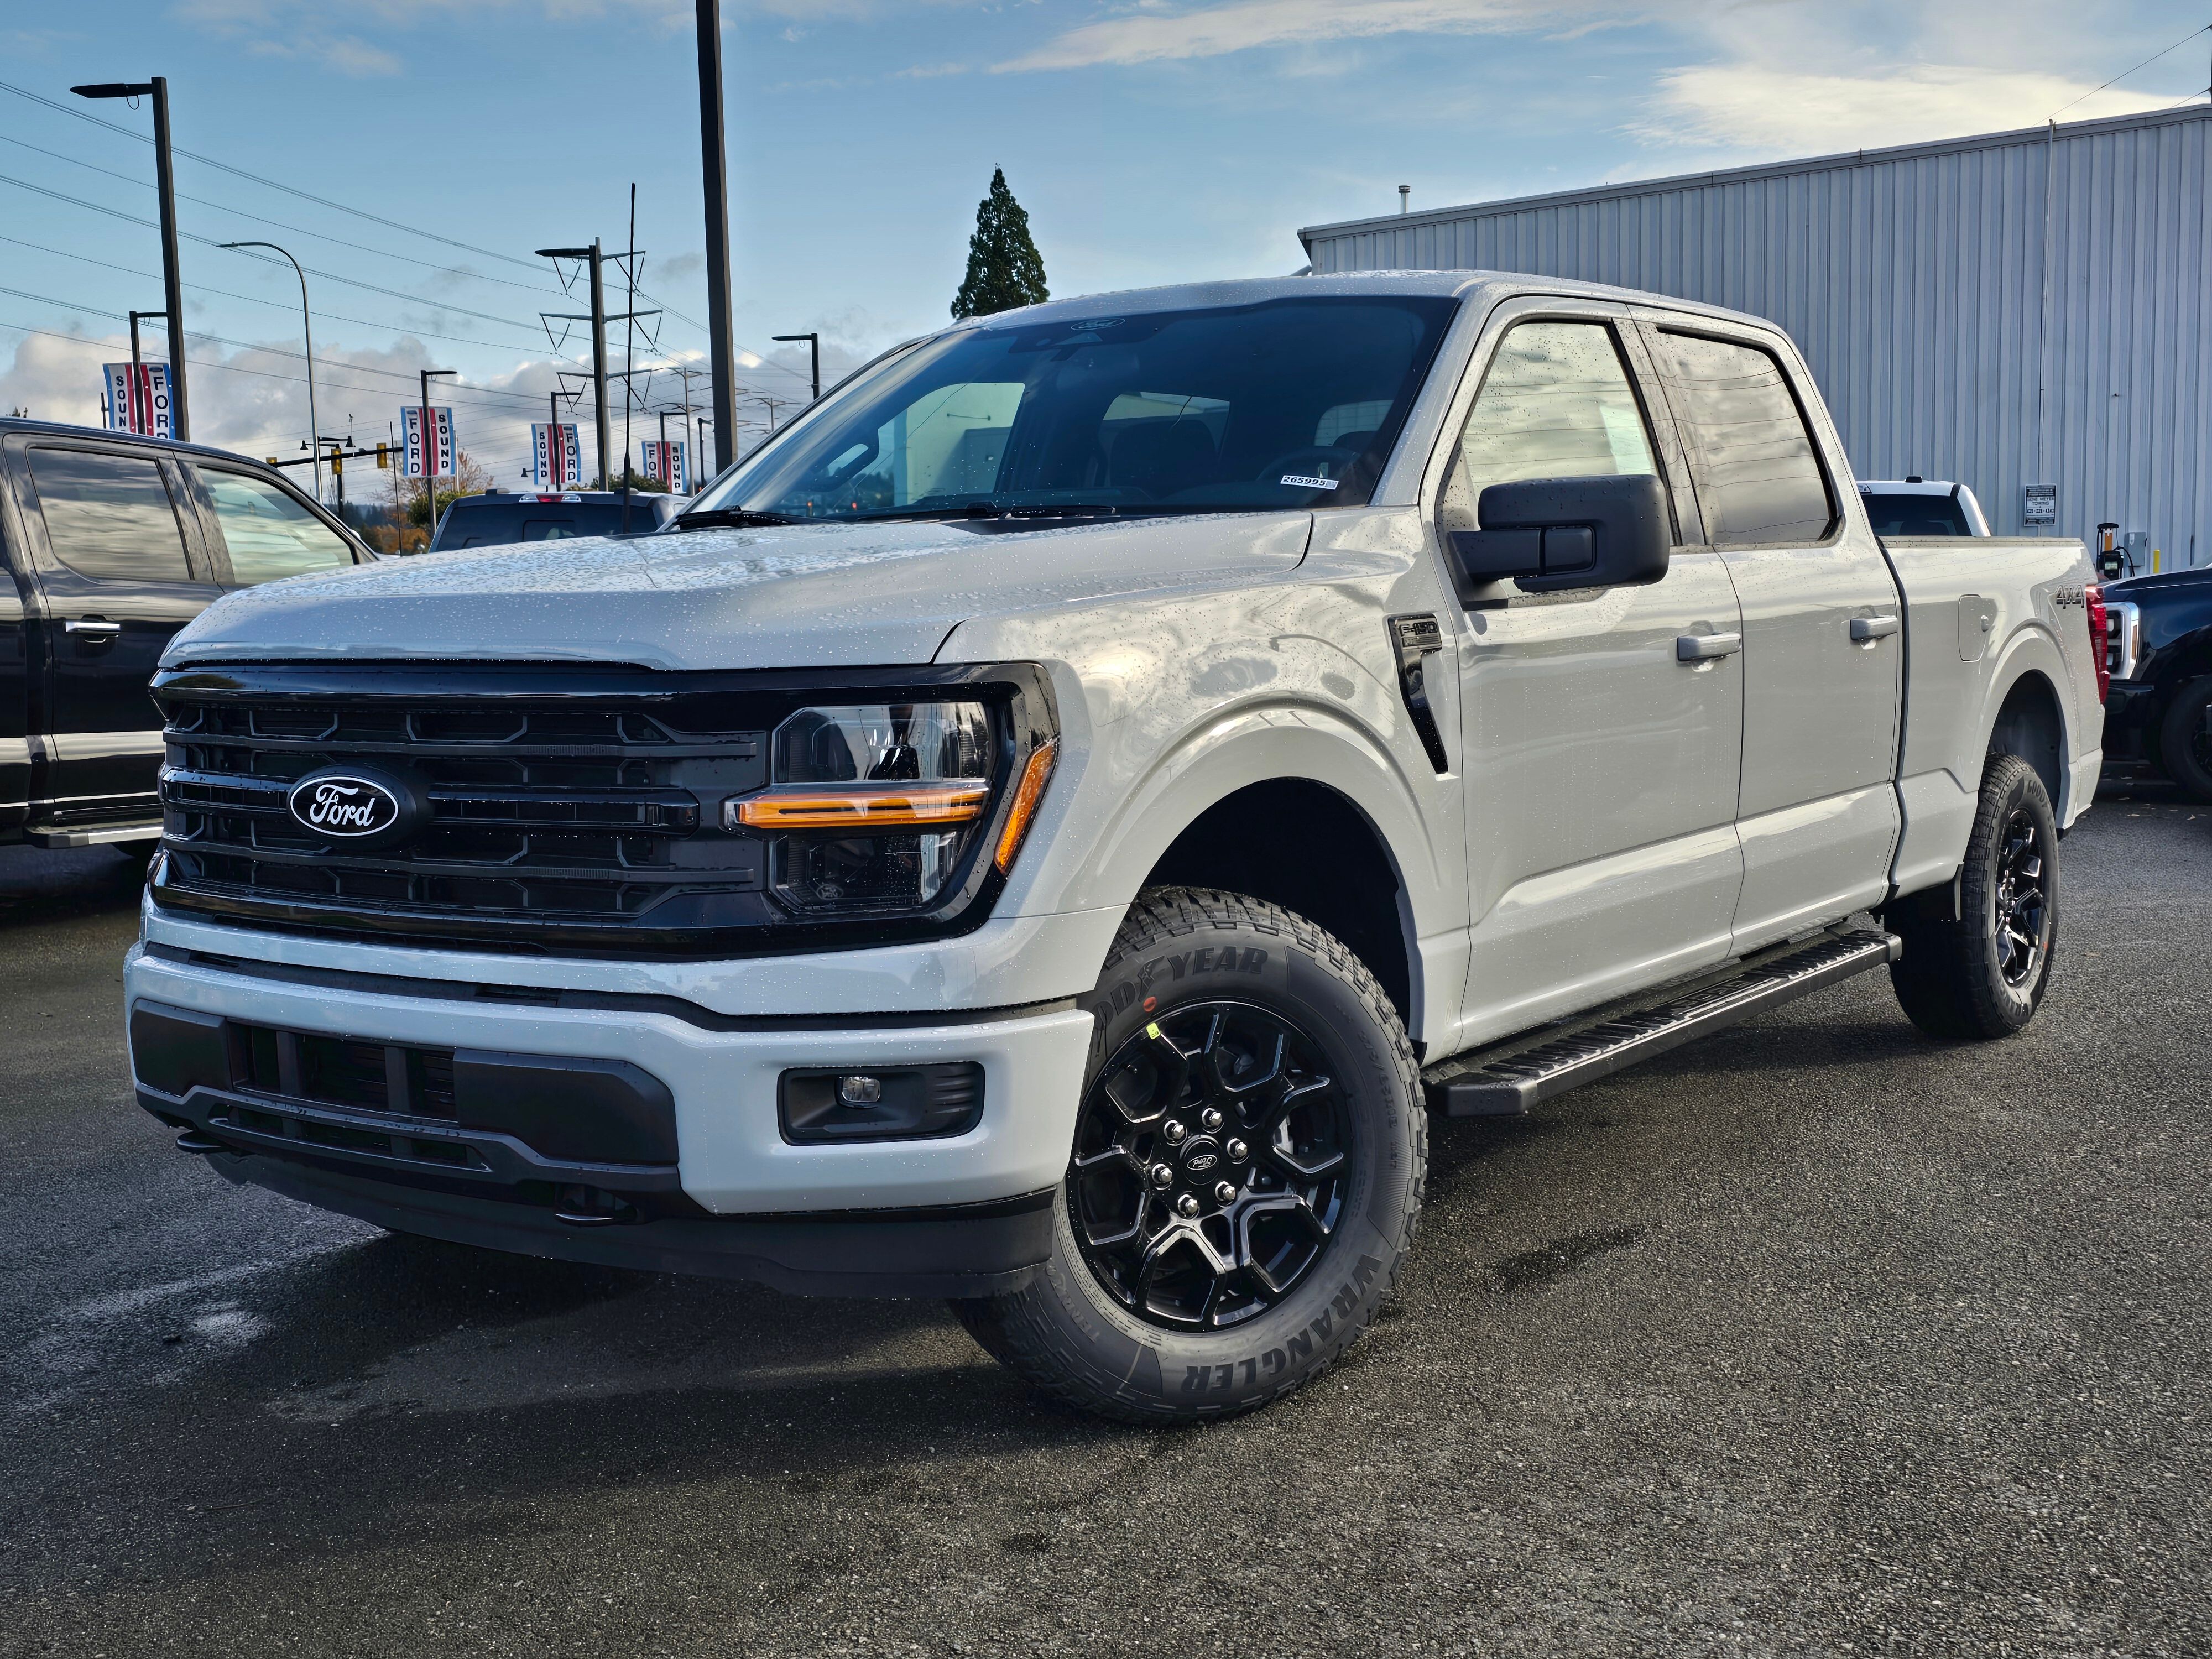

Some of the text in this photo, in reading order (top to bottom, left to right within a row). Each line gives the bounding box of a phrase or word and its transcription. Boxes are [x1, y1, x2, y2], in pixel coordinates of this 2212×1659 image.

[116, 375, 127, 432] SOUN
[409, 418, 420, 473] FORD
[438, 414, 449, 468] SOUND
[539, 432, 547, 477] SOUND
[566, 432, 576, 481] FORD
[649, 450, 657, 480] FOR
[1283, 476, 1326, 486] 265995
[1399, 621, 1438, 637] F-150
[310, 784, 375, 827] Ford
[1181, 1254, 1383, 1392] WRANGLER
